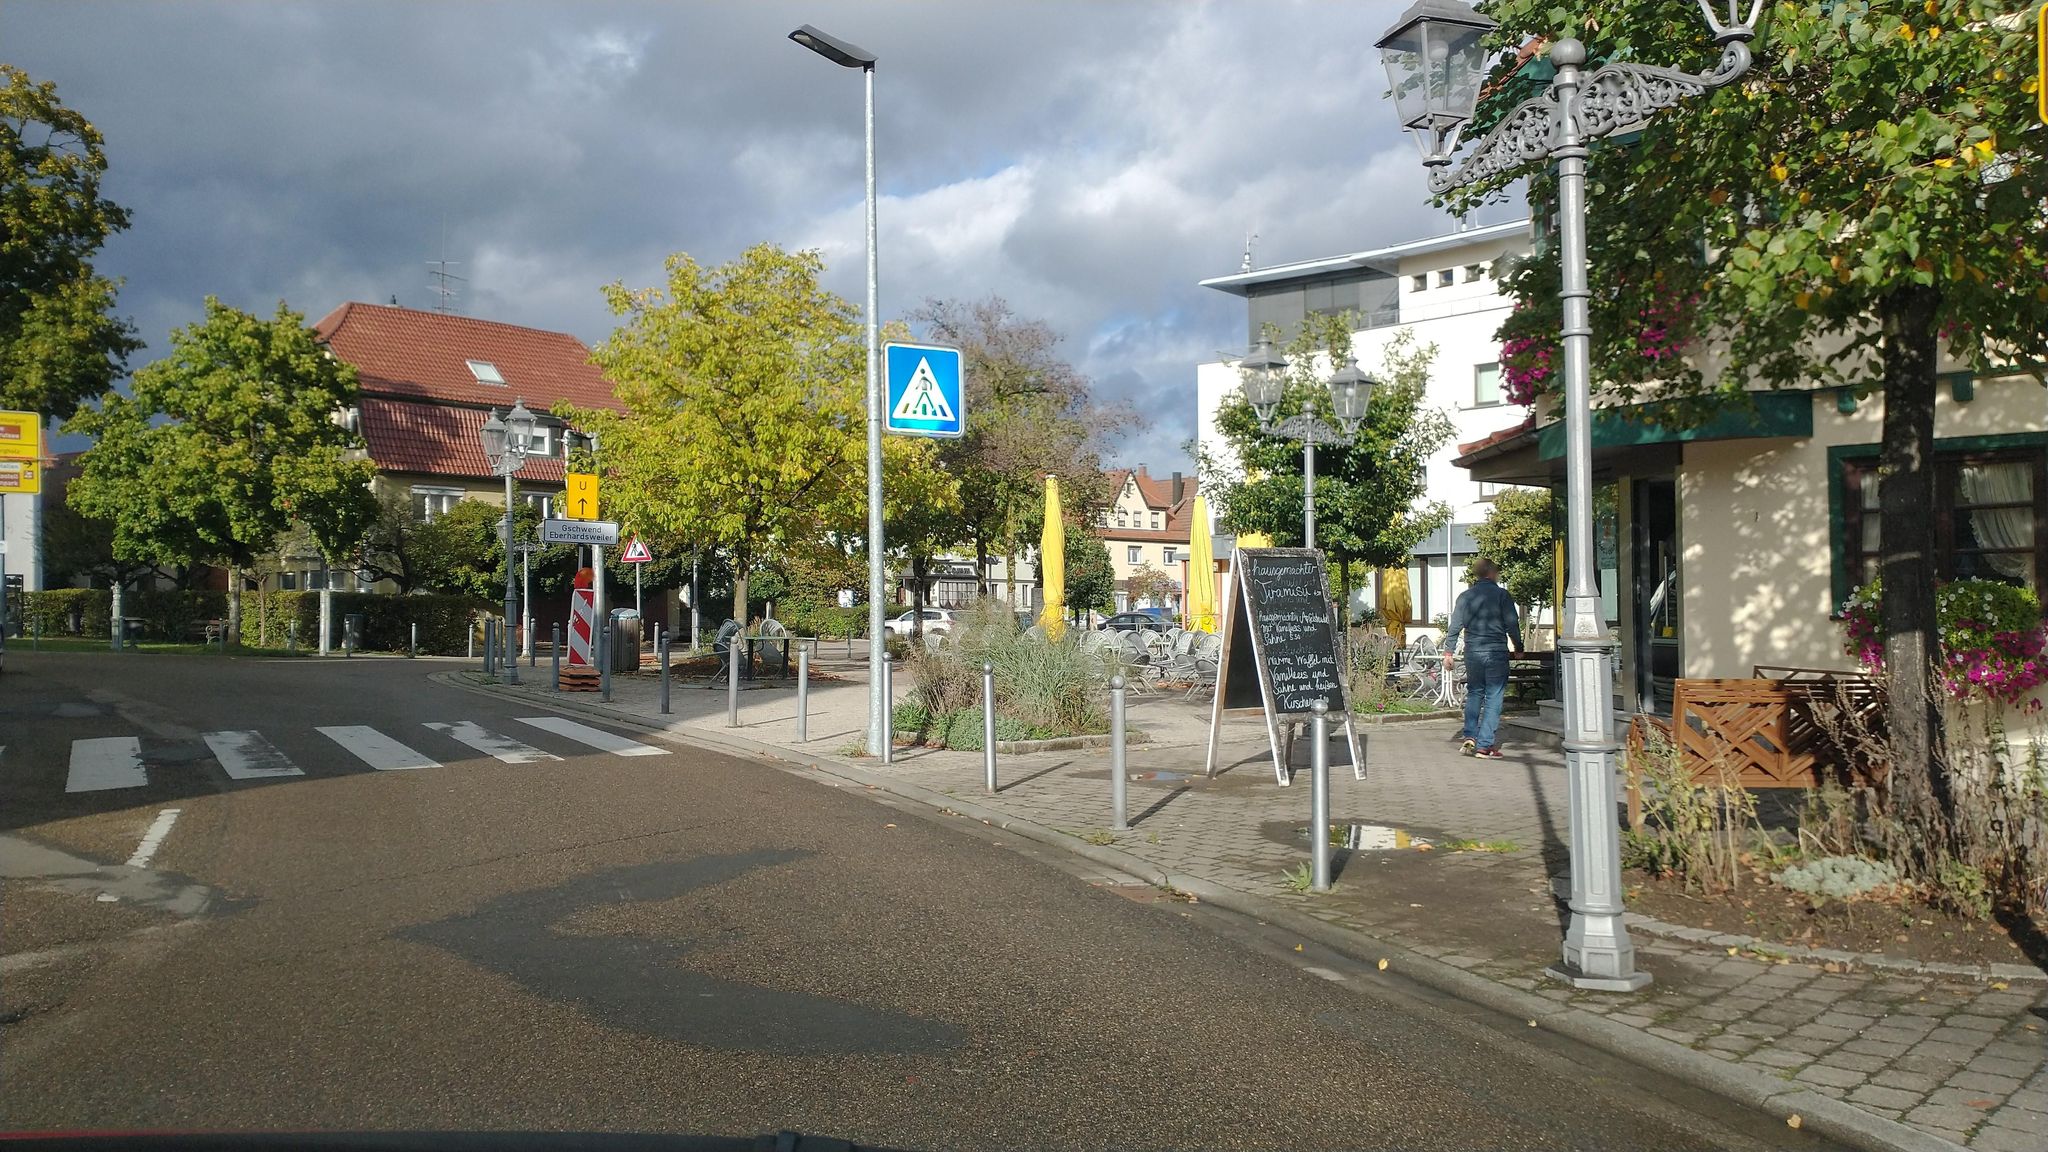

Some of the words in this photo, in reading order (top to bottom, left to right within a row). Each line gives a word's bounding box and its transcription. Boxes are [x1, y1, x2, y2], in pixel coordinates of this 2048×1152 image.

[580, 481, 587, 490] U
[562, 525, 602, 533] Gschwend
[549, 532, 613, 541] Eberhardsweiler
[1295, 653, 1321, 668] Waffel
[1312, 667, 1330, 679] und
[1299, 681, 1314, 691] und
